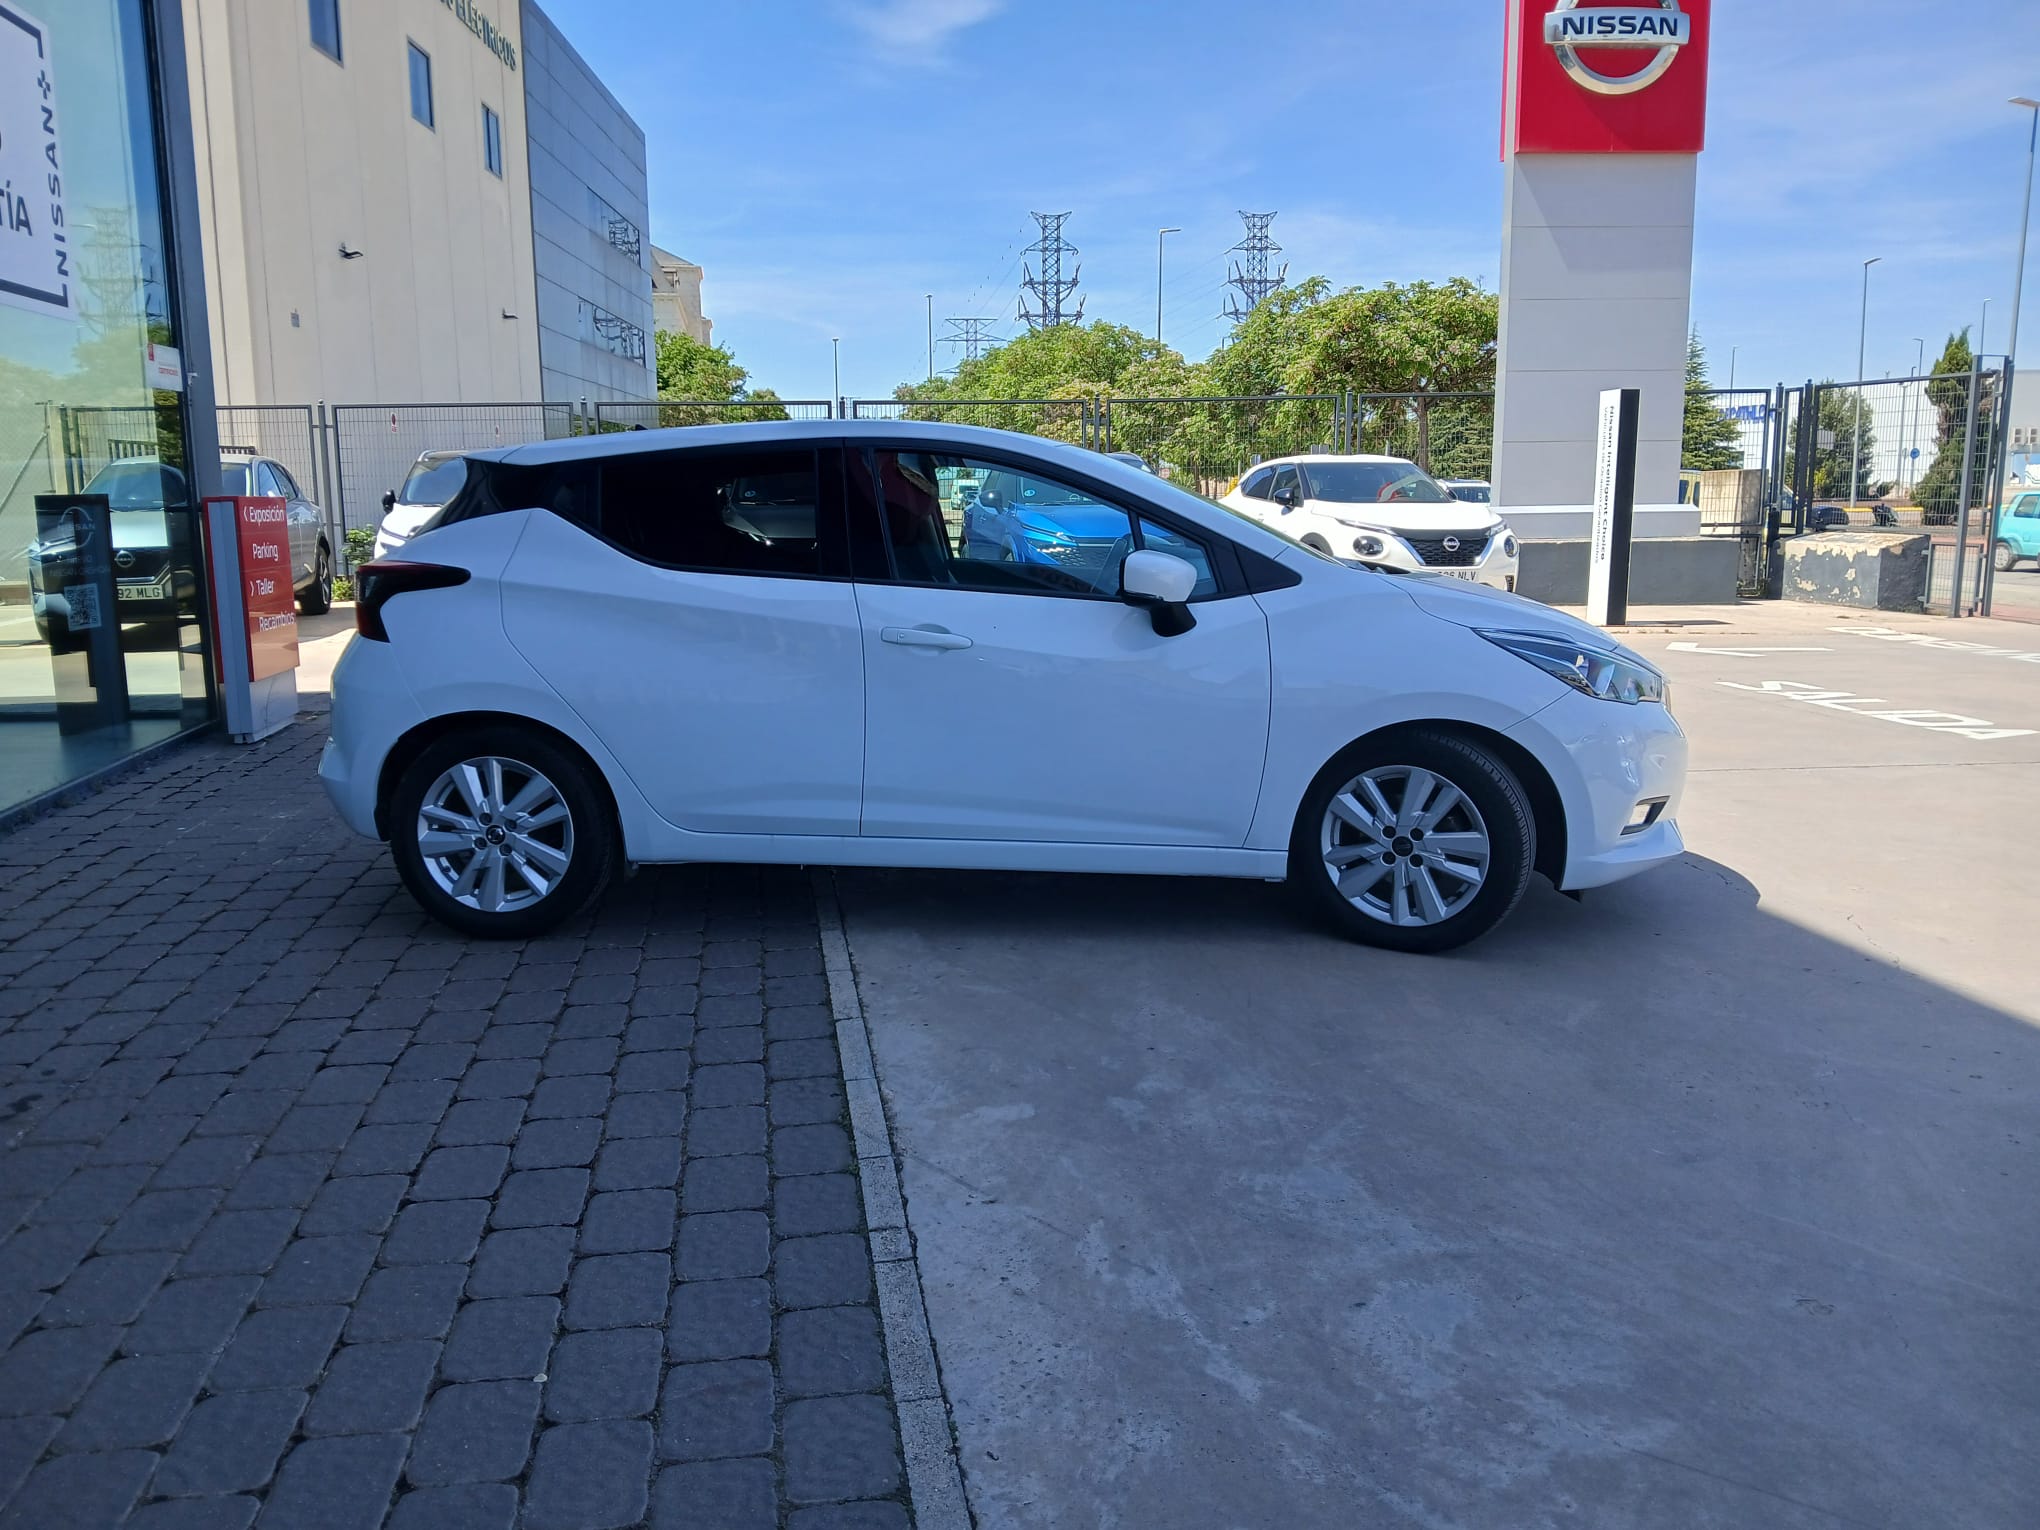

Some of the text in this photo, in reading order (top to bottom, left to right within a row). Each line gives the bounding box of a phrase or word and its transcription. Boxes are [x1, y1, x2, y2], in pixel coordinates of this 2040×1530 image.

[1562, 16, 1678, 36] NISSAN
[249, 505, 285, 526] Exposición
[252, 542, 279, 562] Parking
[136, 587, 160, 598] MLG
[256, 578, 274, 595] Taller
[259, 611, 295, 632] Recambios
